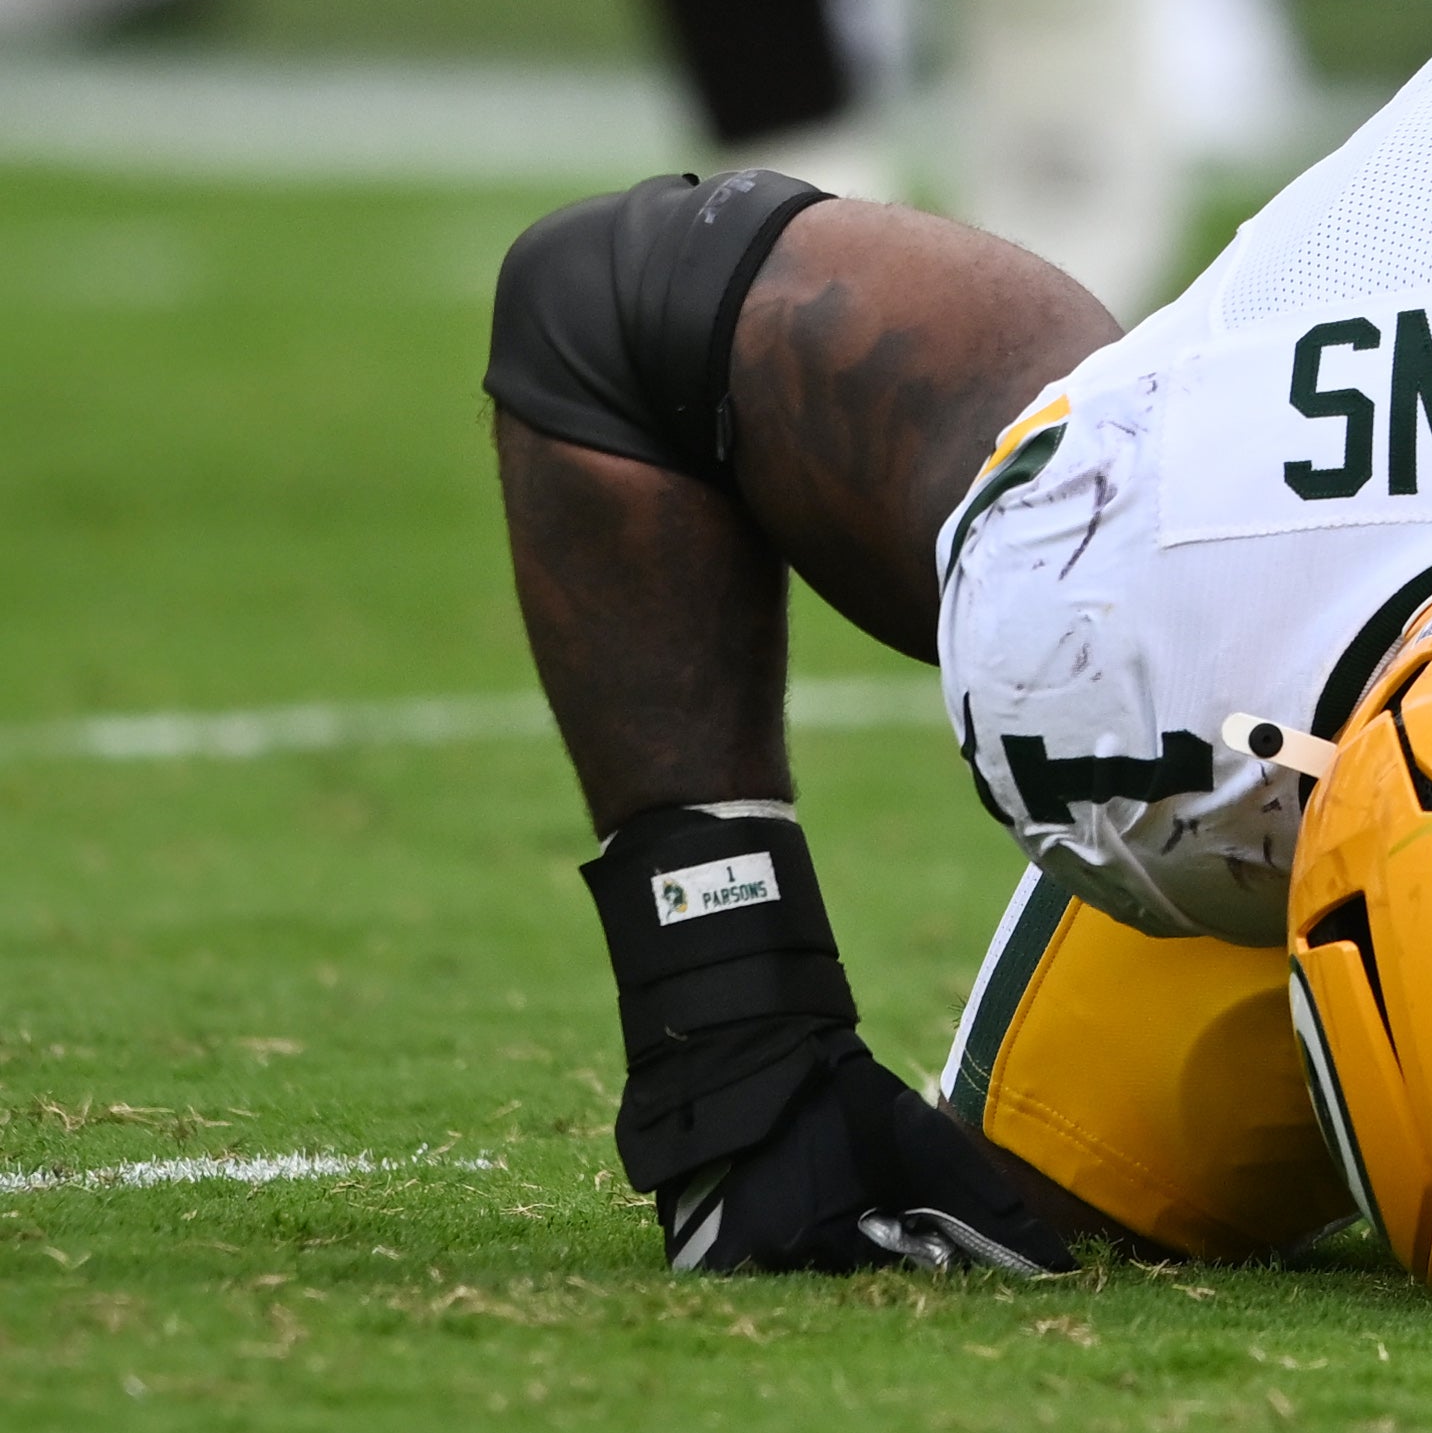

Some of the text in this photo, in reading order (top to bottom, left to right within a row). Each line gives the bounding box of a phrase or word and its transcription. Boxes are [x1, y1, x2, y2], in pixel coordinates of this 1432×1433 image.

[1001, 729, 1214, 824] 1
[726, 866, 736, 882] 1
[702, 881, 767, 910] PARSONS
